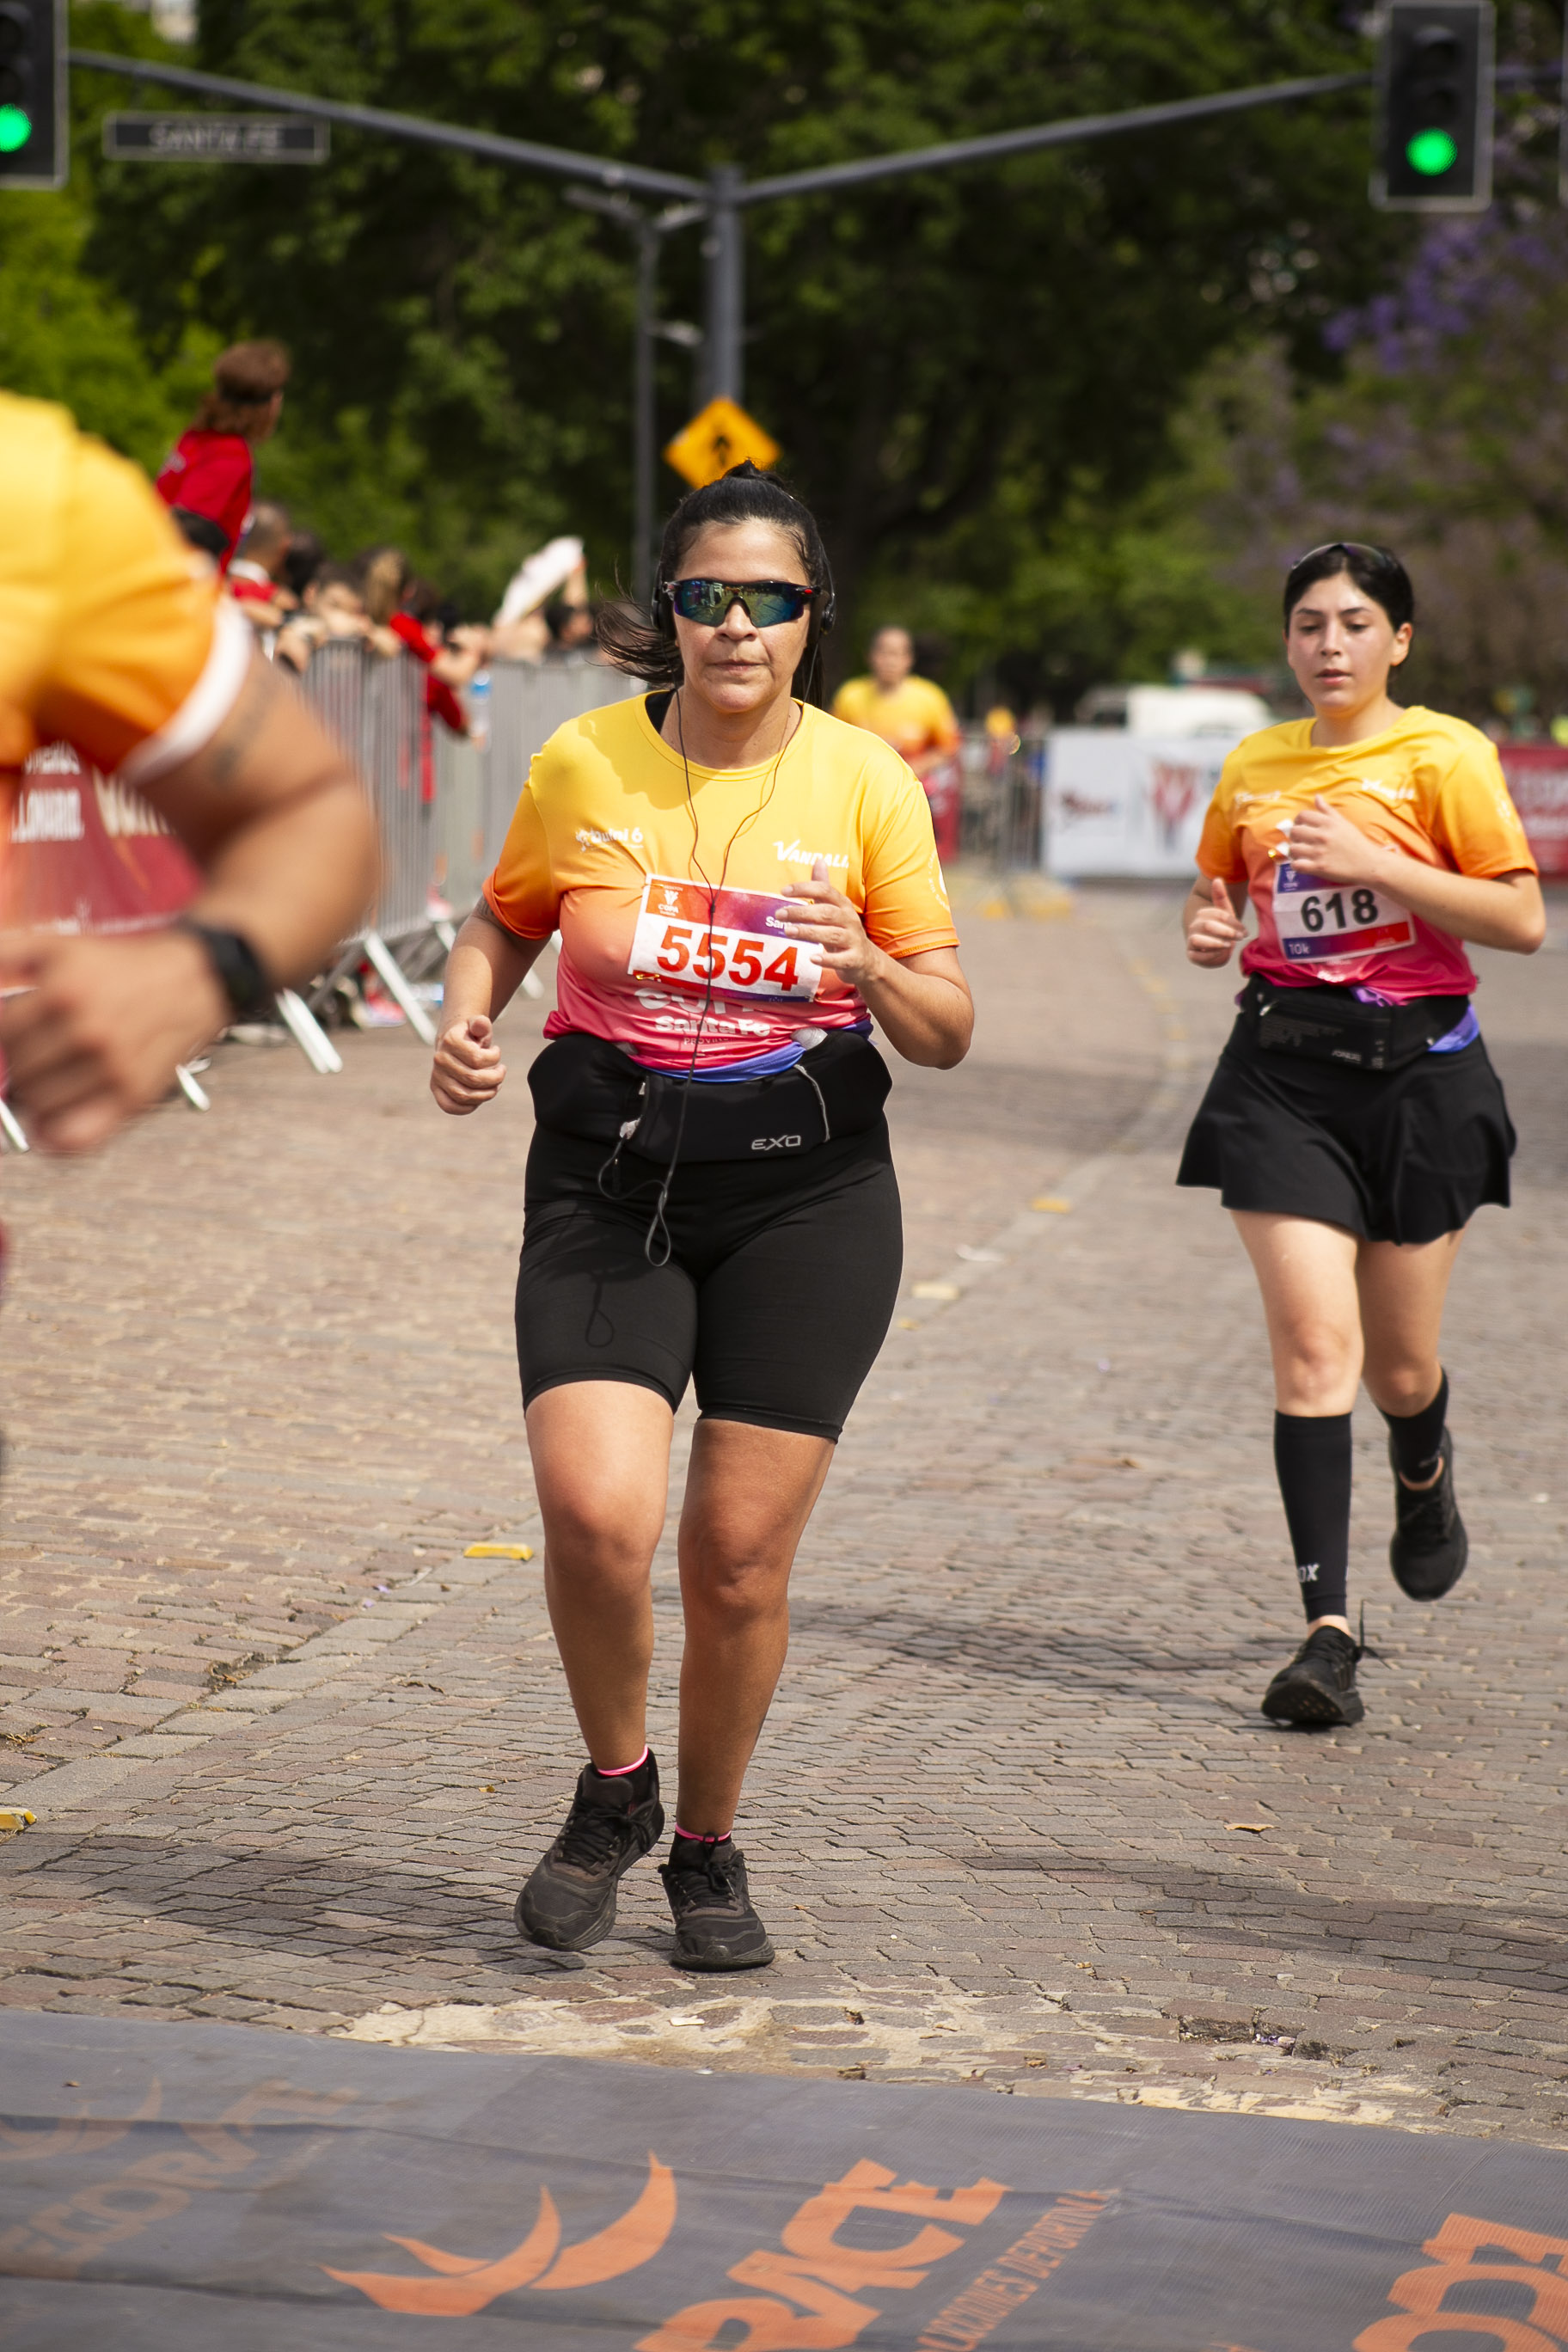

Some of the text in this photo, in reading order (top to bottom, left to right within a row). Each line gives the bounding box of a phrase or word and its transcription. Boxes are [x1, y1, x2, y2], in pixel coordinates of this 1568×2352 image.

[149, 123, 240, 153] SANTA
[631, 827, 643, 843] 6
[1301, 888, 1379, 933] 618
[657, 925, 799, 991] 5554
[1289, 943, 1310, 954] 10k
[655, 1015, 771, 1038] Santa Fe
[751, 1135, 801, 1150] EXO
